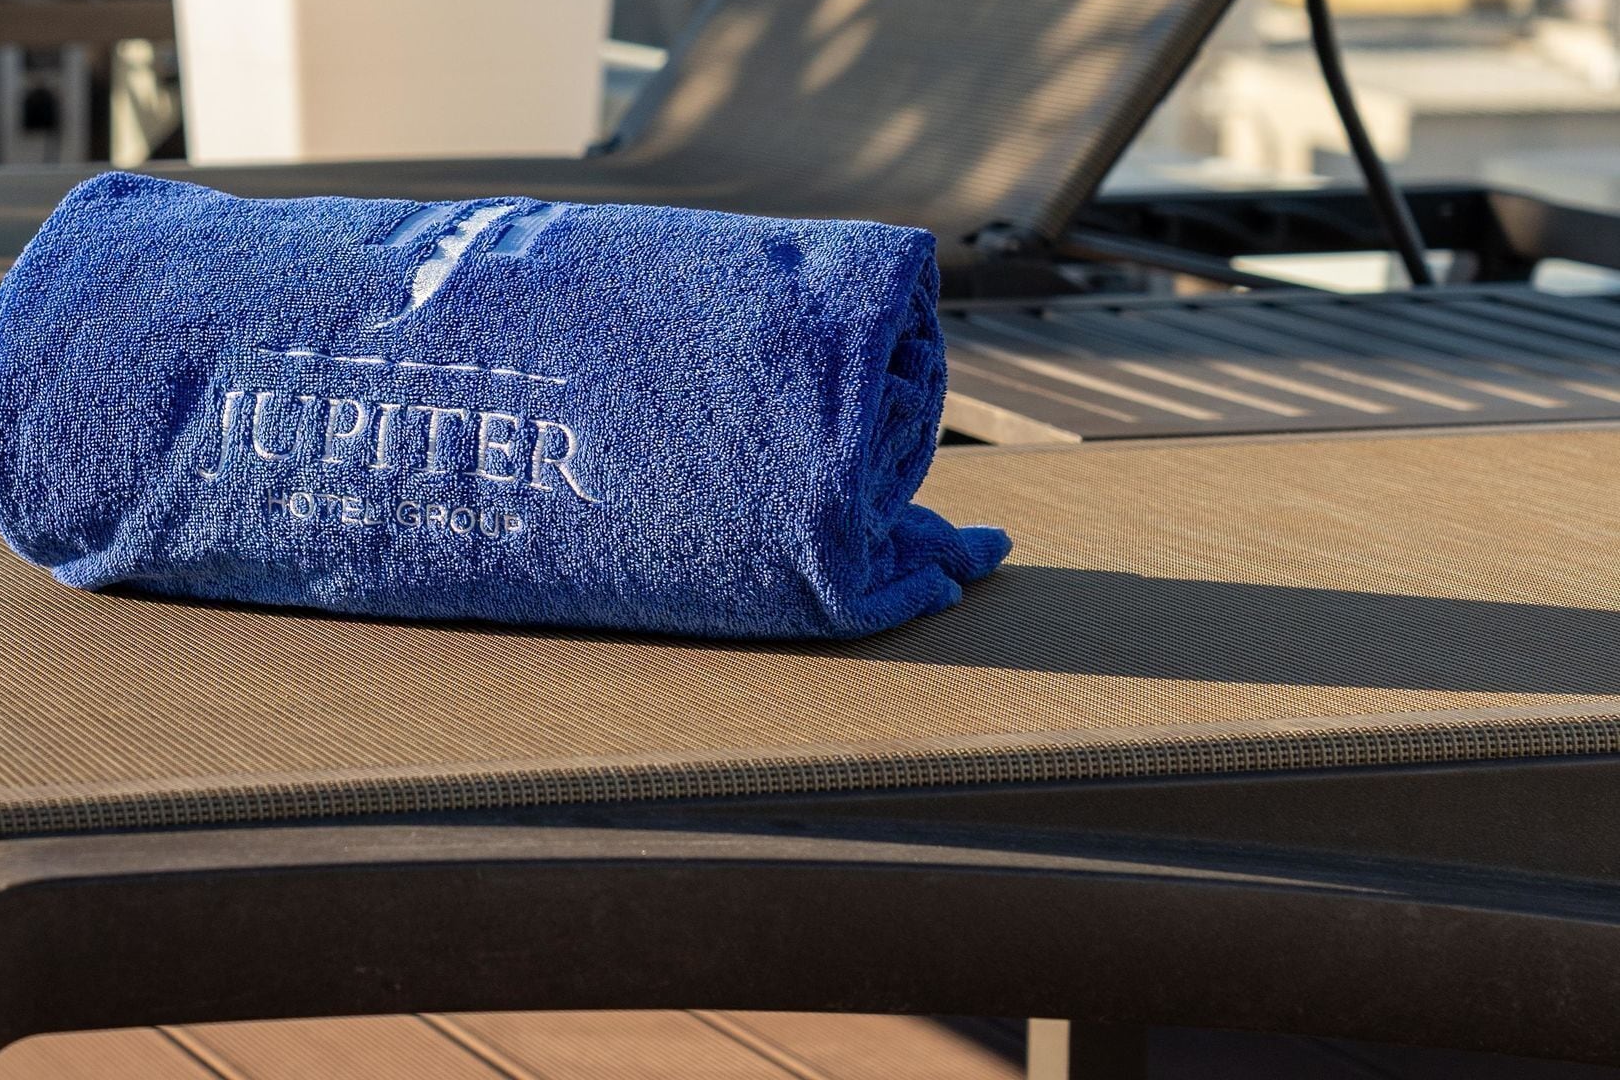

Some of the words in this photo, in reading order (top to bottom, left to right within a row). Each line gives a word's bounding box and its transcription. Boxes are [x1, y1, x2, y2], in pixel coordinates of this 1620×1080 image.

[197, 390, 603, 504] JUPITER
[266, 488, 385, 526] HOTEL
[396, 500, 522, 538] GROUP
